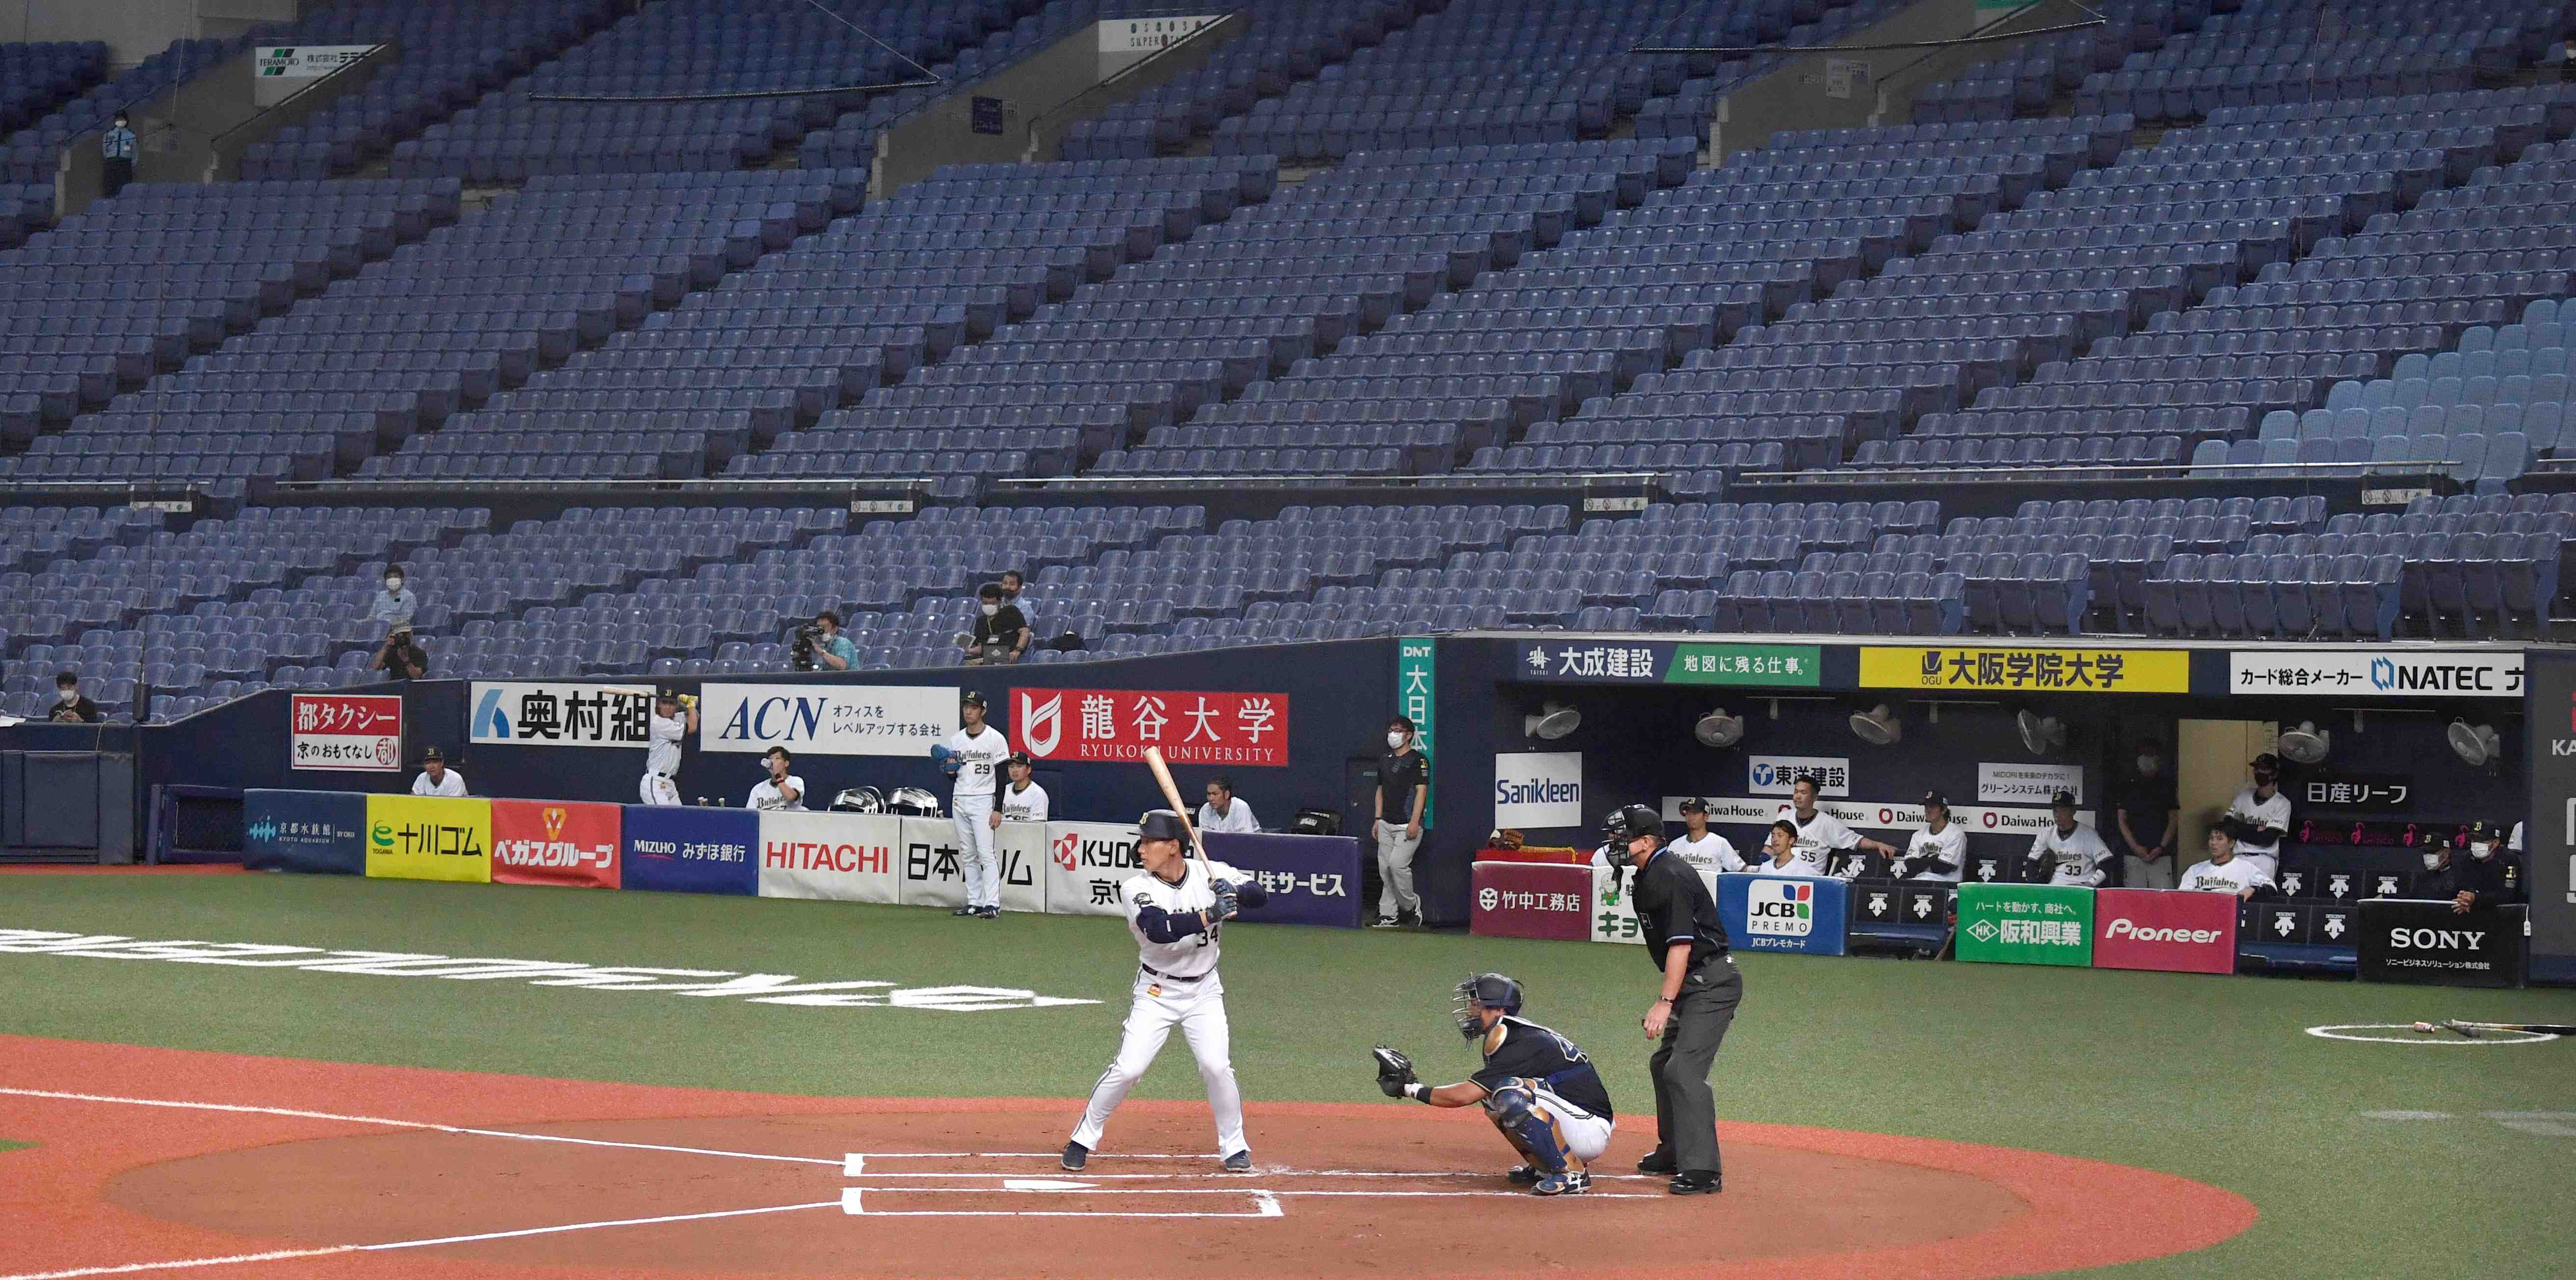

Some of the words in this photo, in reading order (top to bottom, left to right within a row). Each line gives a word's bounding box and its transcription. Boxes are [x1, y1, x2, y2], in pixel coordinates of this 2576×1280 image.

[260, 58, 299, 66] TERAMOTO
[1403, 646, 1432, 658] DNT
[1559, 646, 1654, 678] 大成建設
[1684, 655, 1803, 675] 地図に残る仕事。
[1948, 651, 2124, 688] 大阪学院大学
[1921, 676, 1942, 685] OGU
[2241, 668, 2363, 686] カード総合メーカー
[2399, 666, 2493, 691] NATEC
[297, 701, 396, 731] 都タクシー
[518, 689, 651, 741] 奥村組
[718, 696, 829, 741] ACN
[833, 705, 884, 718] オフィスを
[1080, 694, 1275, 744] 龍谷大学
[833, 722, 941, 737] レベルアップする会社
[297, 741, 372, 759] 京のおもてなし
[1168, 746, 1274, 762] UNIVERSITY
[974, 764, 990, 774] 29
[1497, 777, 1579, 804] Sanikleen
[2308, 782, 2407, 804] 日産リーフ
[1731, 804, 1764, 816] House
[1139, 812, 1149, 825] B
[2001, 815, 2037, 827] Daiwa
[279, 822, 330, 836] 京都水族館
[2473, 822, 2482, 831] B
[397, 823, 483, 857] 十川ゴム
[634, 839, 676, 854] MIZUHO
[2424, 835, 2431, 843] B
[494, 840, 614, 869] ベガスグループ
[682, 842, 746, 863] みずほ銀行
[766, 841, 888, 874] HITACHI
[1800, 850, 1817, 862] 55
[2065, 864, 2081, 876] 33
[1502, 890, 1580, 912] 竹中工務店
[1976, 901, 2077, 915] ハートを動かす、商社へ。
[1750, 902, 1795, 917] JCB
[1752, 920, 1807, 933] PREMO
[1976, 925, 1991, 936] HK
[2000, 919, 2082, 946] 阪和興業
[1196, 925, 1218, 948] 34
[1751, 938, 1806, 949] JCBプレモカード
[2390, 928, 2486, 950] SONY
[2386, 958, 2491, 970] ソニービジネスソリューション株式会社
